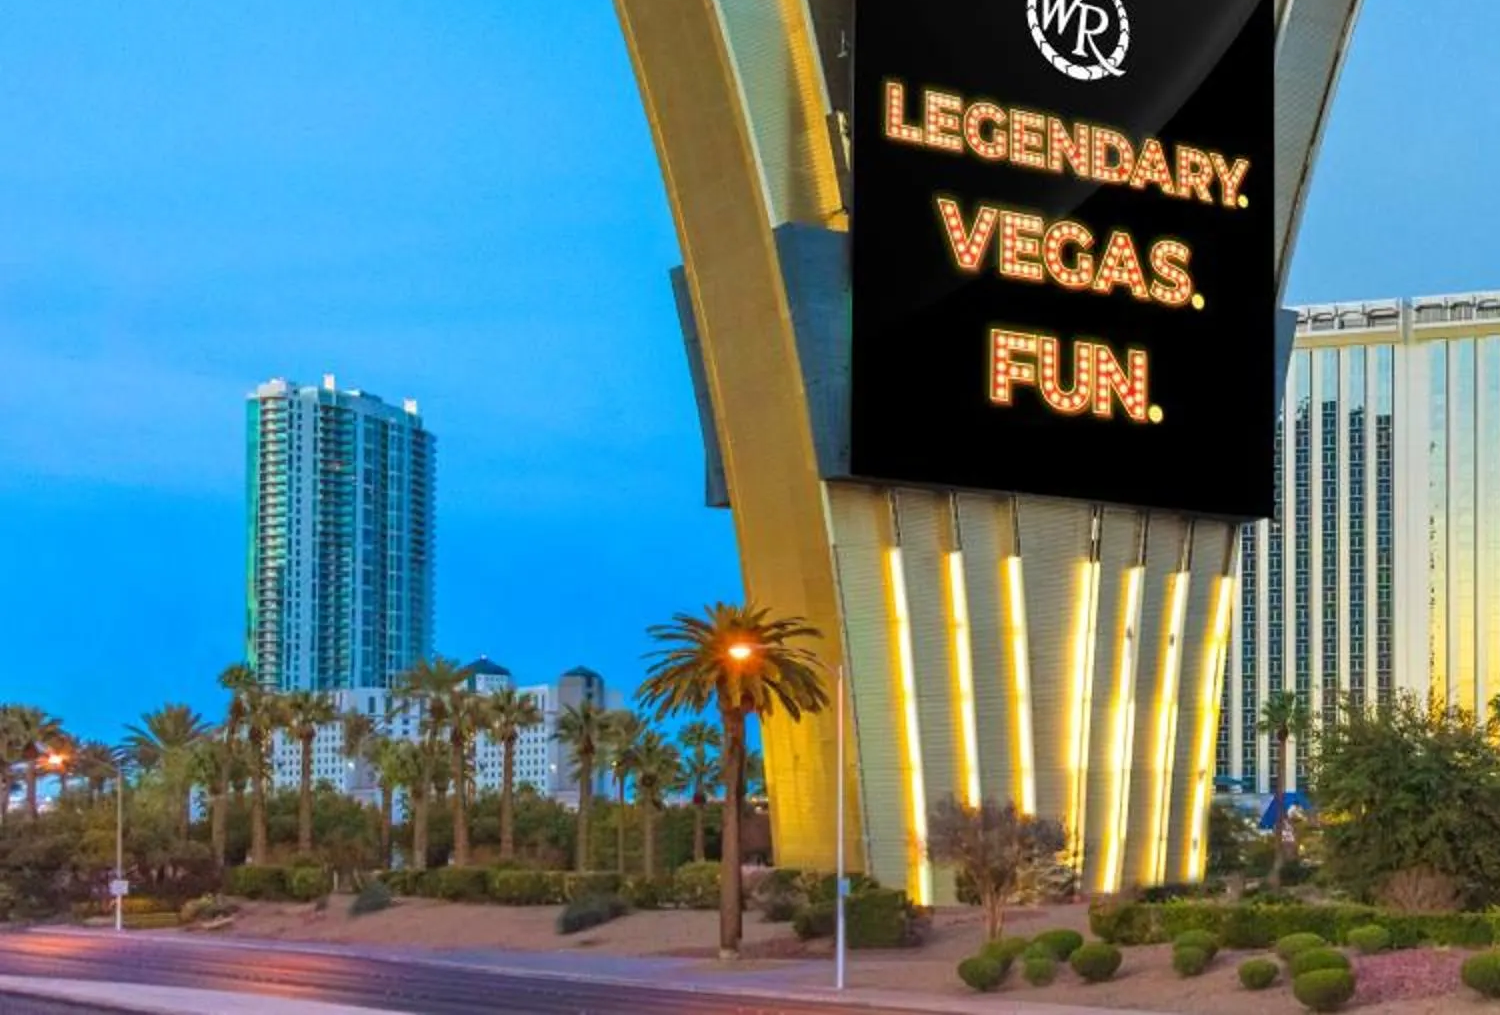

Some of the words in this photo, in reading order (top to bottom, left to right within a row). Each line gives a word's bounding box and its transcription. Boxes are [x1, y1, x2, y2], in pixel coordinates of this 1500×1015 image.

[885, 82, 1249, 209] LEGENDARY.
[936, 198, 1206, 310] VEGAS.
[989, 328, 1164, 424] FUN.
